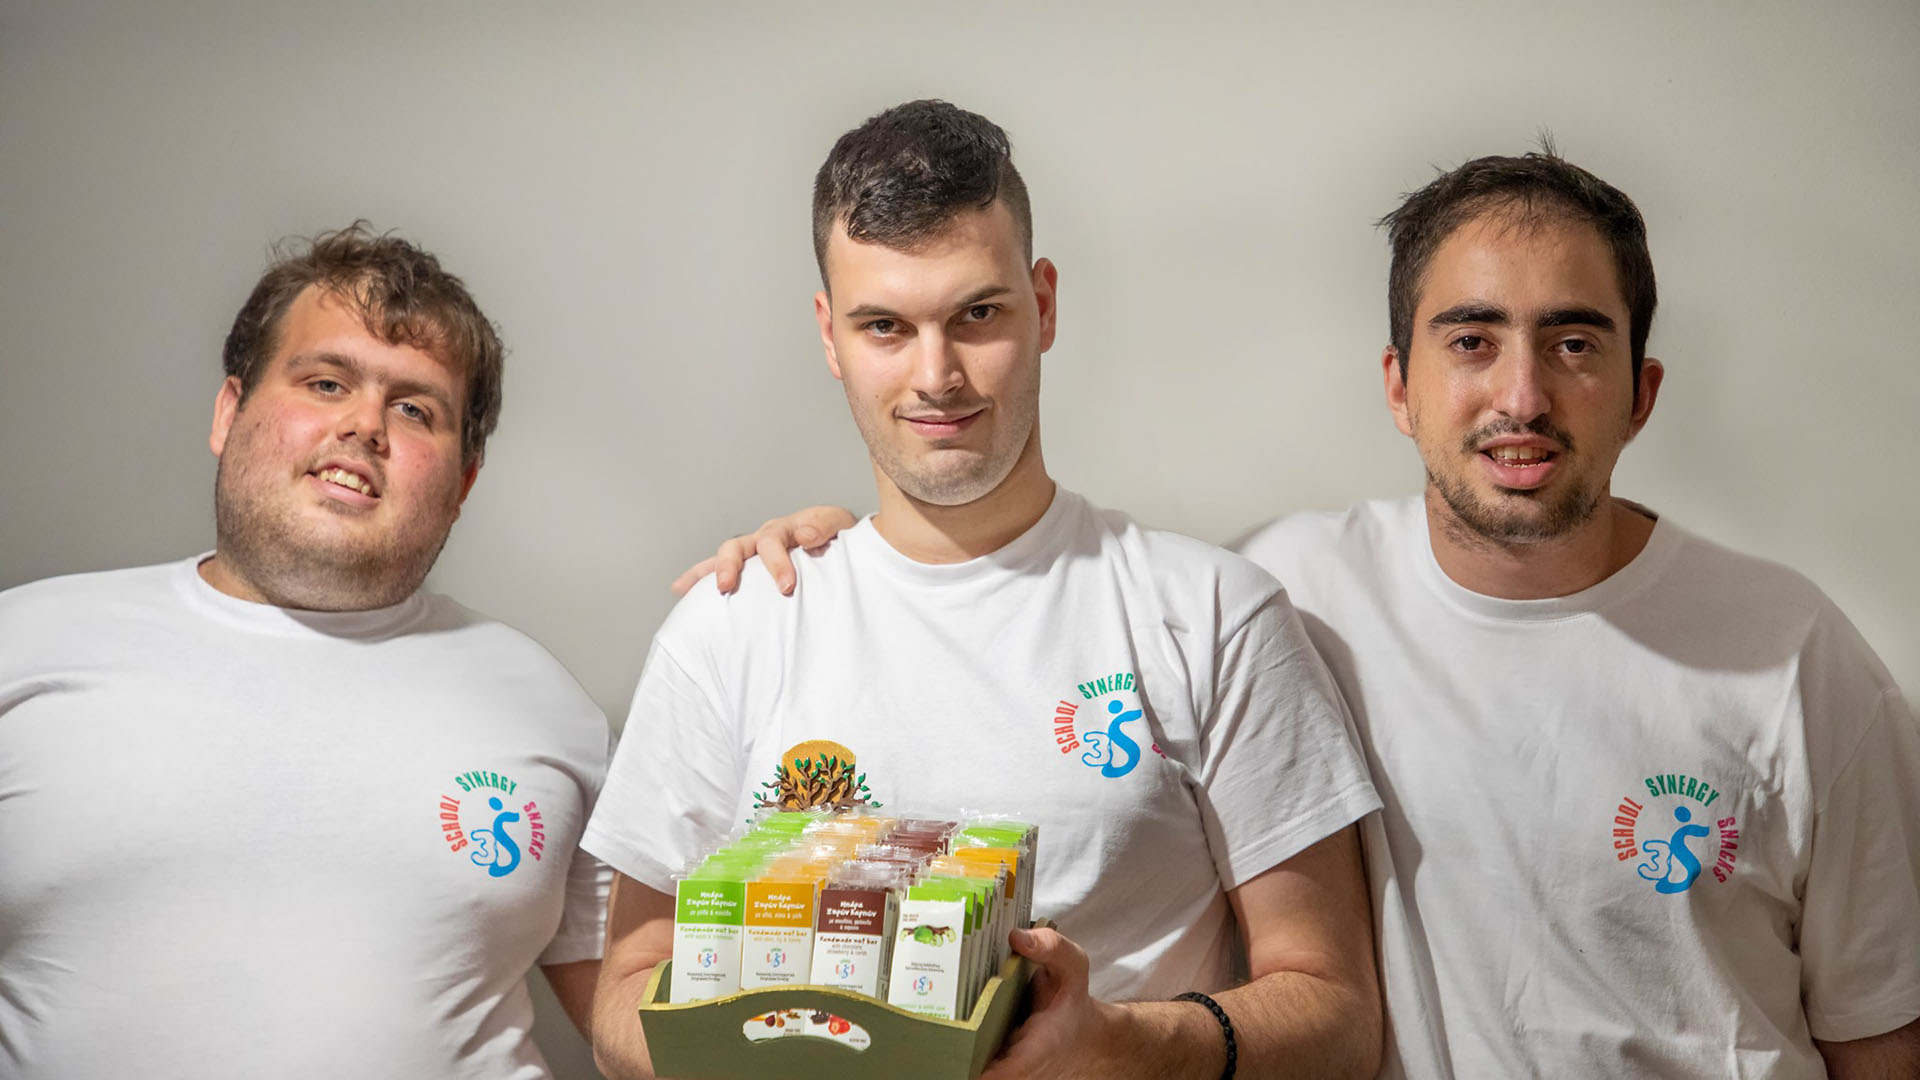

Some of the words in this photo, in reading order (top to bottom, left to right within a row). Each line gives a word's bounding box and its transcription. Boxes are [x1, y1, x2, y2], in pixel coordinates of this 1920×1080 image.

[1054, 700, 1080, 754] SCHOOL
[440, 795, 468, 852] SCHOOL
[455, 770, 517, 795] SYNERGY
[523, 801, 545, 861] SNACKS
[1613, 797, 1643, 861] SCHOOL
[1645, 774, 1719, 807] SYNERGY
[1712, 816, 1739, 884] SNACKS
